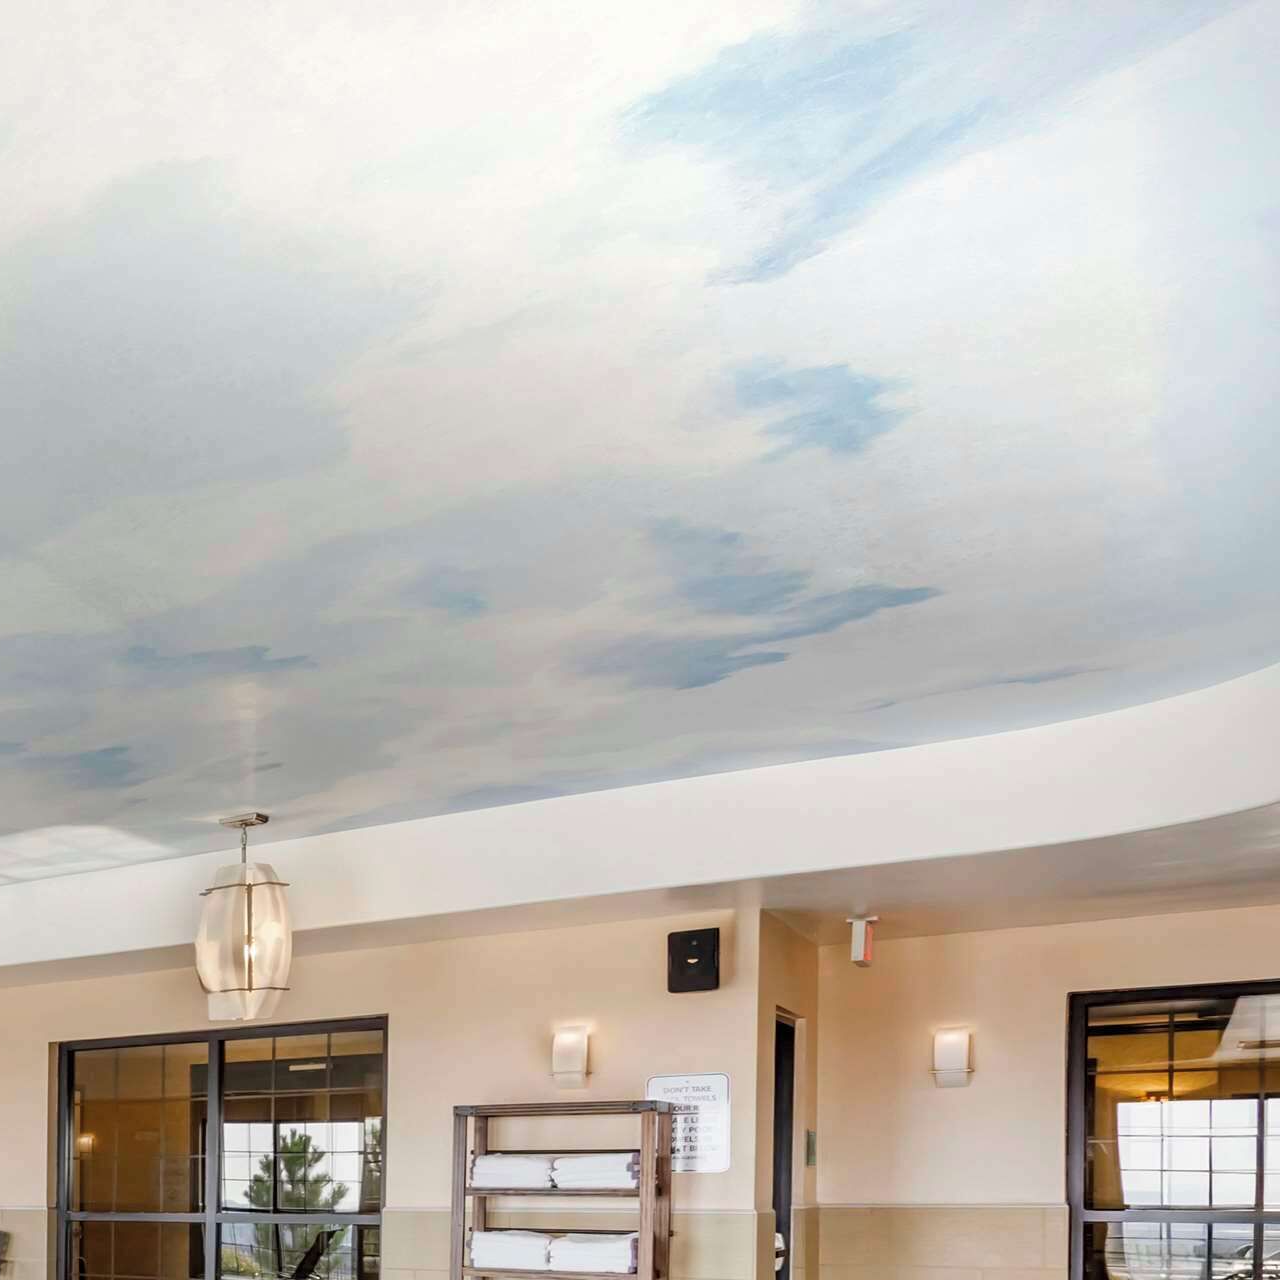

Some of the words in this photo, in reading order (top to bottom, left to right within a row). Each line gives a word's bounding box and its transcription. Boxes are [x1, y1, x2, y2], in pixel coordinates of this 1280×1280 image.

[663, 1086, 689, 1094] DON'T
[691, 1085, 712, 1093] TAKE
[671, 1104, 691, 1112] OUR
